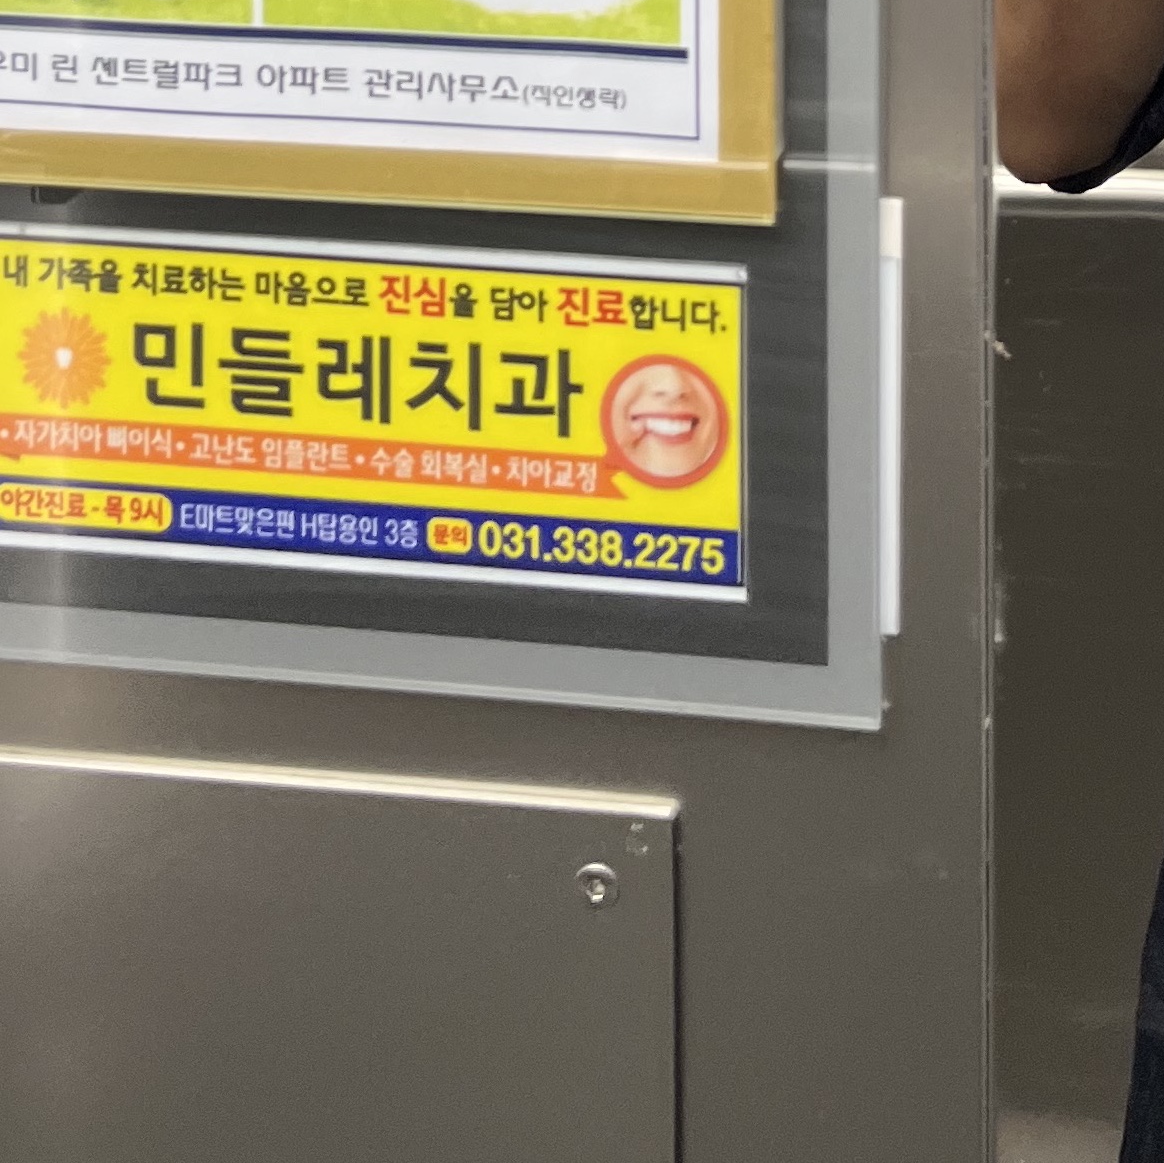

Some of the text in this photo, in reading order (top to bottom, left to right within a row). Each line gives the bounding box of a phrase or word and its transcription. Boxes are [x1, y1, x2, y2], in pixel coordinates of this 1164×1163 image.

[51, 53, 78, 84] 린
[91, 55, 243, 91] 센트럴파크
[257, 61, 351, 97] 아파트
[2, 255, 728, 334] 내 가족을 치료하는 마음으로 진심을 담아 진료합니다.
[133, 321, 585, 439] 민들레치과
[14, 418, 103, 453] 자가치아
[189, 432, 257, 466] 고난도
[262, 439, 352, 471] 임플란트
[370, 446, 415, 478] 수술
[420, 448, 488, 483] 회복실
[506, 455, 599, 494] 치아교정
[129, 495, 165, 528] 9시
[384, 517, 420, 549] 3층
[432, 523, 469, 548] 문의
[478, 520, 727, 576] 031.338.2275
